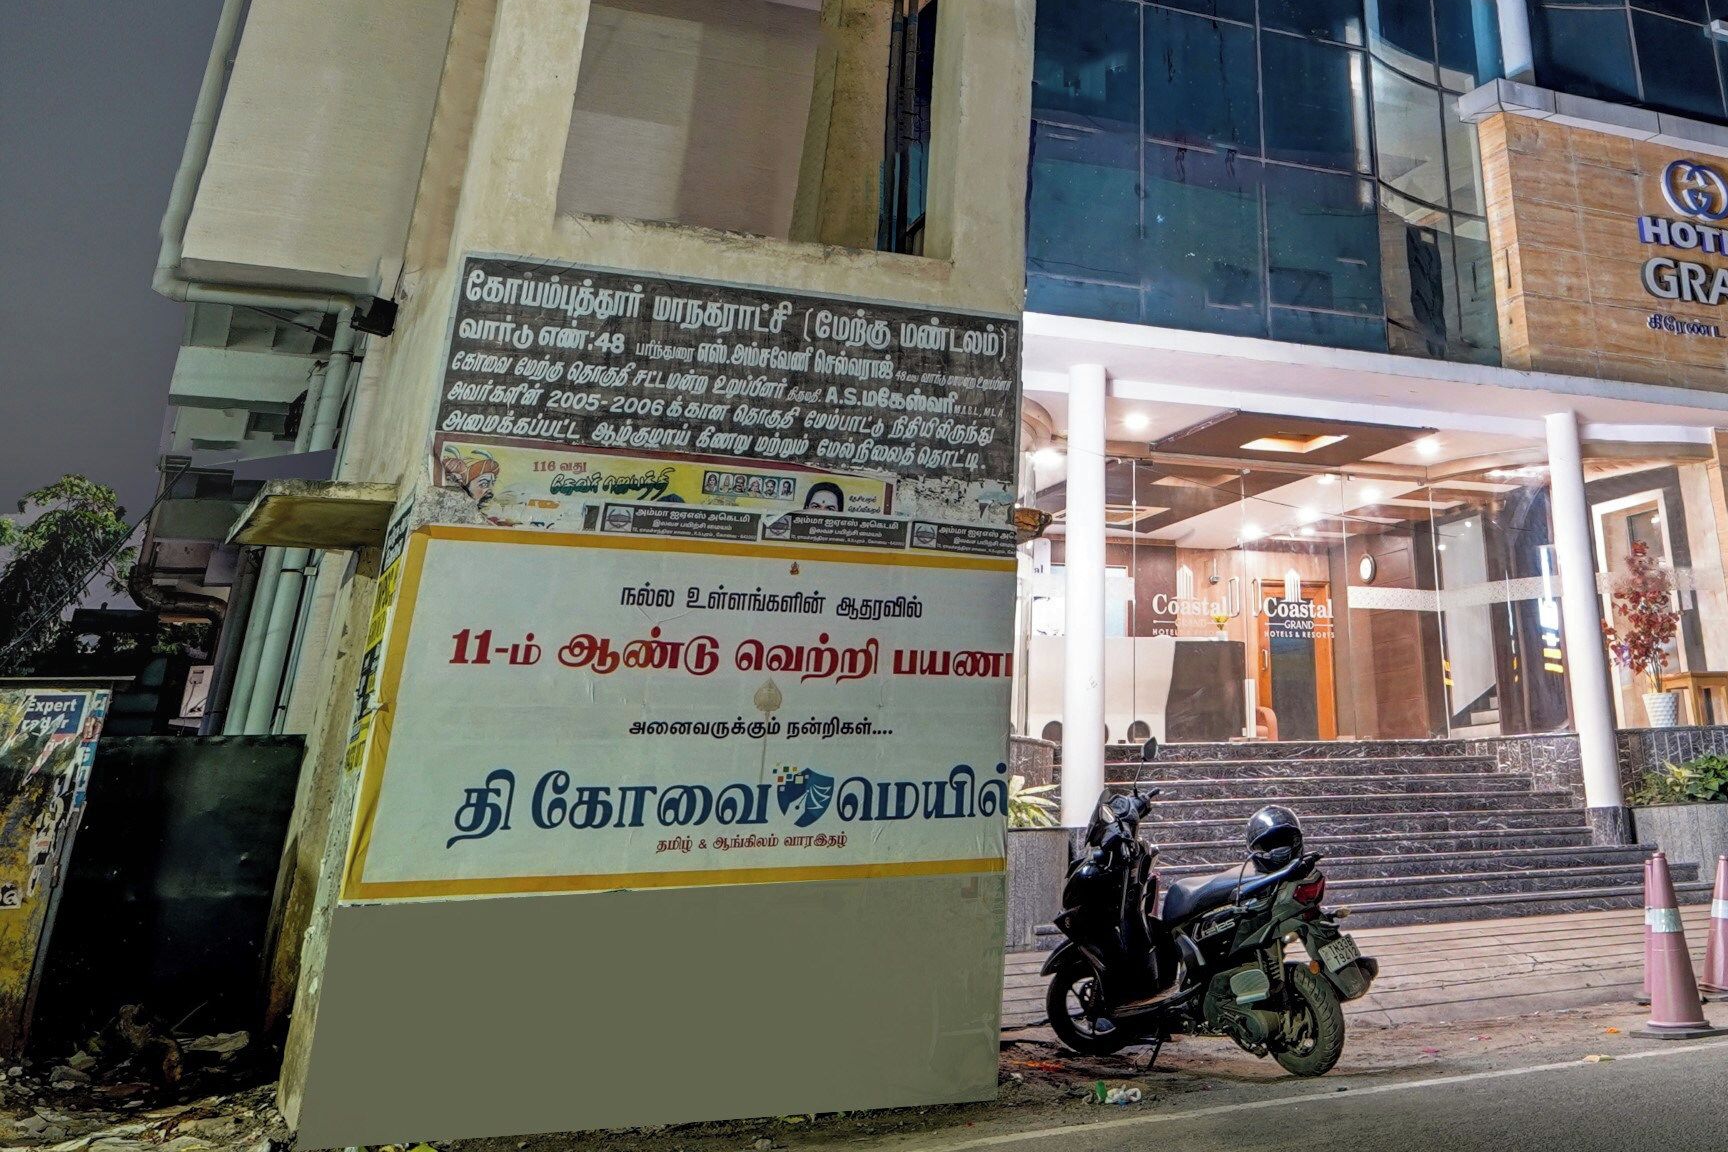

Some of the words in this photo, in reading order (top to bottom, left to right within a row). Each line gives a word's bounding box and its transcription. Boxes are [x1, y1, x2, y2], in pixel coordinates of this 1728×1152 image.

[653, 295, 792, 333] மாநகராட்சி
[804, 307, 891, 349] (மேற்கு
[900, 316, 1007, 362] மண்டலம்)
[459, 315, 534, 348] வார்டு
[814, 348, 894, 381] செல்வராஜ்
[451, 351, 511, 373] கோவை
[514, 354, 565, 382] மேற்கு
[567, 360, 636, 388] தொகுதி
[633, 369, 709, 395] சட்டமன்ற
[714, 374, 788, 399] உறுப்பினர்
[447, 379, 544, 406] அவர்களின்
[733, 404, 800, 430] தொகுதி
[804, 409, 884, 438] மேம்பாட்டு
[888, 415, 995, 447] நிதியிலிருந்து
[442, 408, 581, 439] அமைக்கப்பட்ட
[696, 425, 751, 453] கிணறு
[755, 433, 810, 458] மற்றும்
[533, 461, 556, 473] 116
[560, 462, 587, 474] வது
[635, 508, 668, 517] அம்மா
[670, 510, 706, 520] ஐஏஎஸ்
[793, 516, 822, 525] அம்மா
[939, 526, 967, 535] அம்மா
[620, 581, 675, 608] நல்ல
[686, 584, 826, 614] உள்ளங்களின்
[836, 594, 922, 620] ஆதரவில்
[1152, 593, 1234, 618] Coastal
[1263, 597, 1334, 619] Coastal
[1265, 630, 1295, 639] HOTELS
[1302, 631, 1335, 639] RESORTS
[1284, 619, 1314, 630] GRAND
[449, 628, 542, 665] 11-ம்
[557, 625, 719, 676] ஆண்டு
[735, 632, 879, 685] வெற்றி
[893, 649, 1013, 678] பயண
[27, 698, 77, 715] Expert
[629, 716, 781, 739] அனைவருக்கும்
[787, 716, 894, 739] நன்றிகள்....
[446, 768, 516, 849] தி
[531, 769, 773, 830] கோவை
[836, 762, 1009, 823] மெயில்
[656, 835, 692, 854] தமிழ்
[698, 839, 708, 850] &
[713, 833, 778, 851] ஆங்கிலம்
